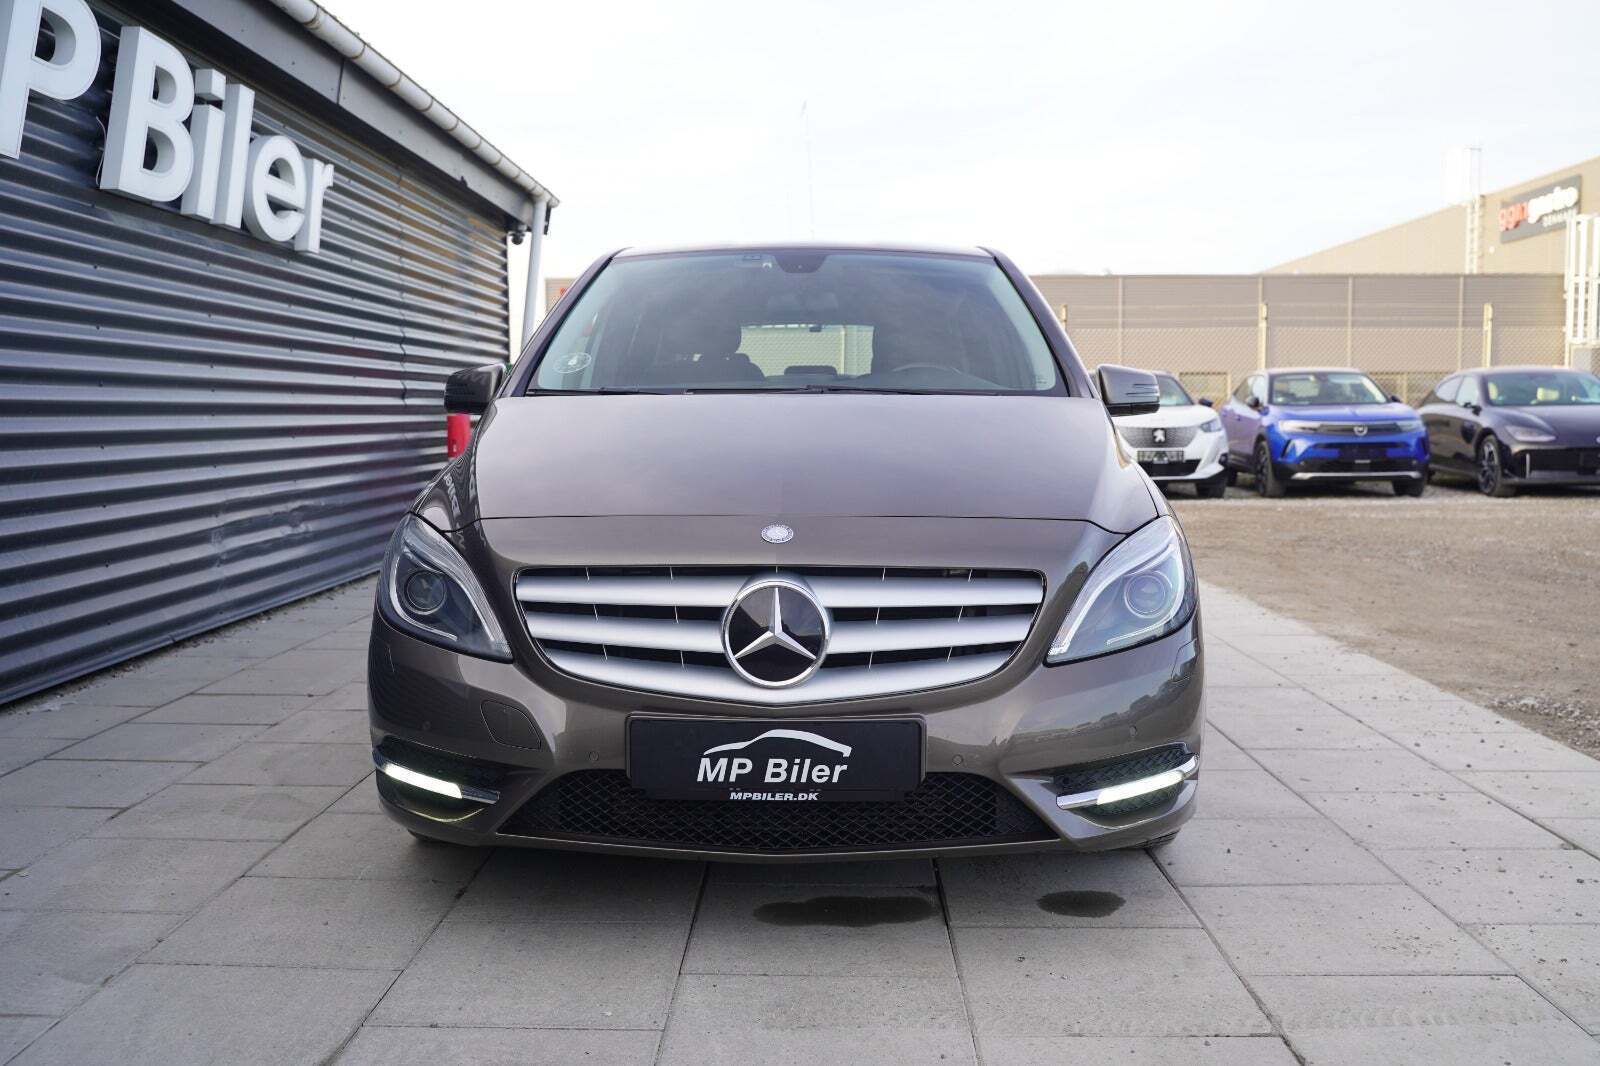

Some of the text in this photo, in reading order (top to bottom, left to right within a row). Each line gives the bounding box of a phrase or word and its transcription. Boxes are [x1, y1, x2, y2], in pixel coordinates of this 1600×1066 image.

[100, 26, 334, 252] Biler
[697, 757, 848, 783] MP Biler
[729, 791, 820, 801] MPBILER.DK
